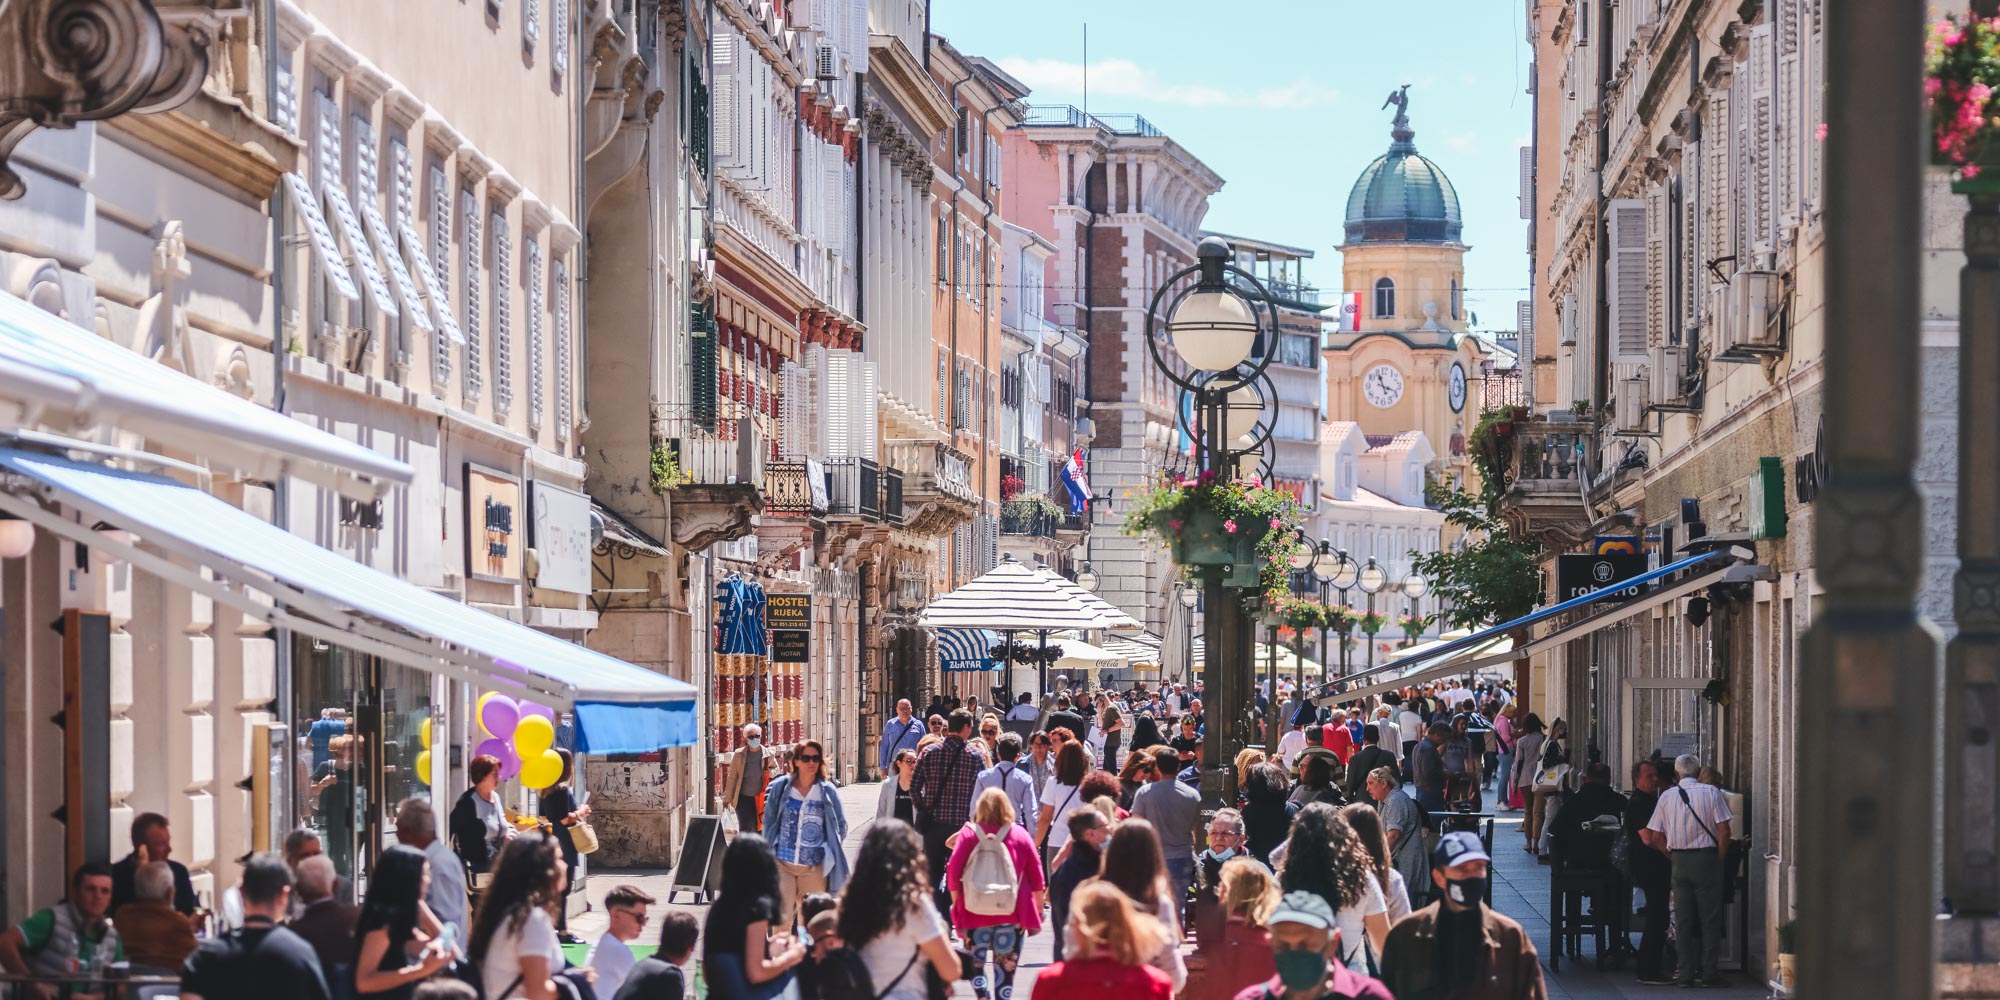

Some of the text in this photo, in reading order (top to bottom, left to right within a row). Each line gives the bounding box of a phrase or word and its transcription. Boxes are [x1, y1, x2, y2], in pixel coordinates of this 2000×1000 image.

[768, 597, 809, 607] HOSTEL
[773, 609, 803, 617] RIJEKA
[949, 660, 982, 669] ZLATAR
